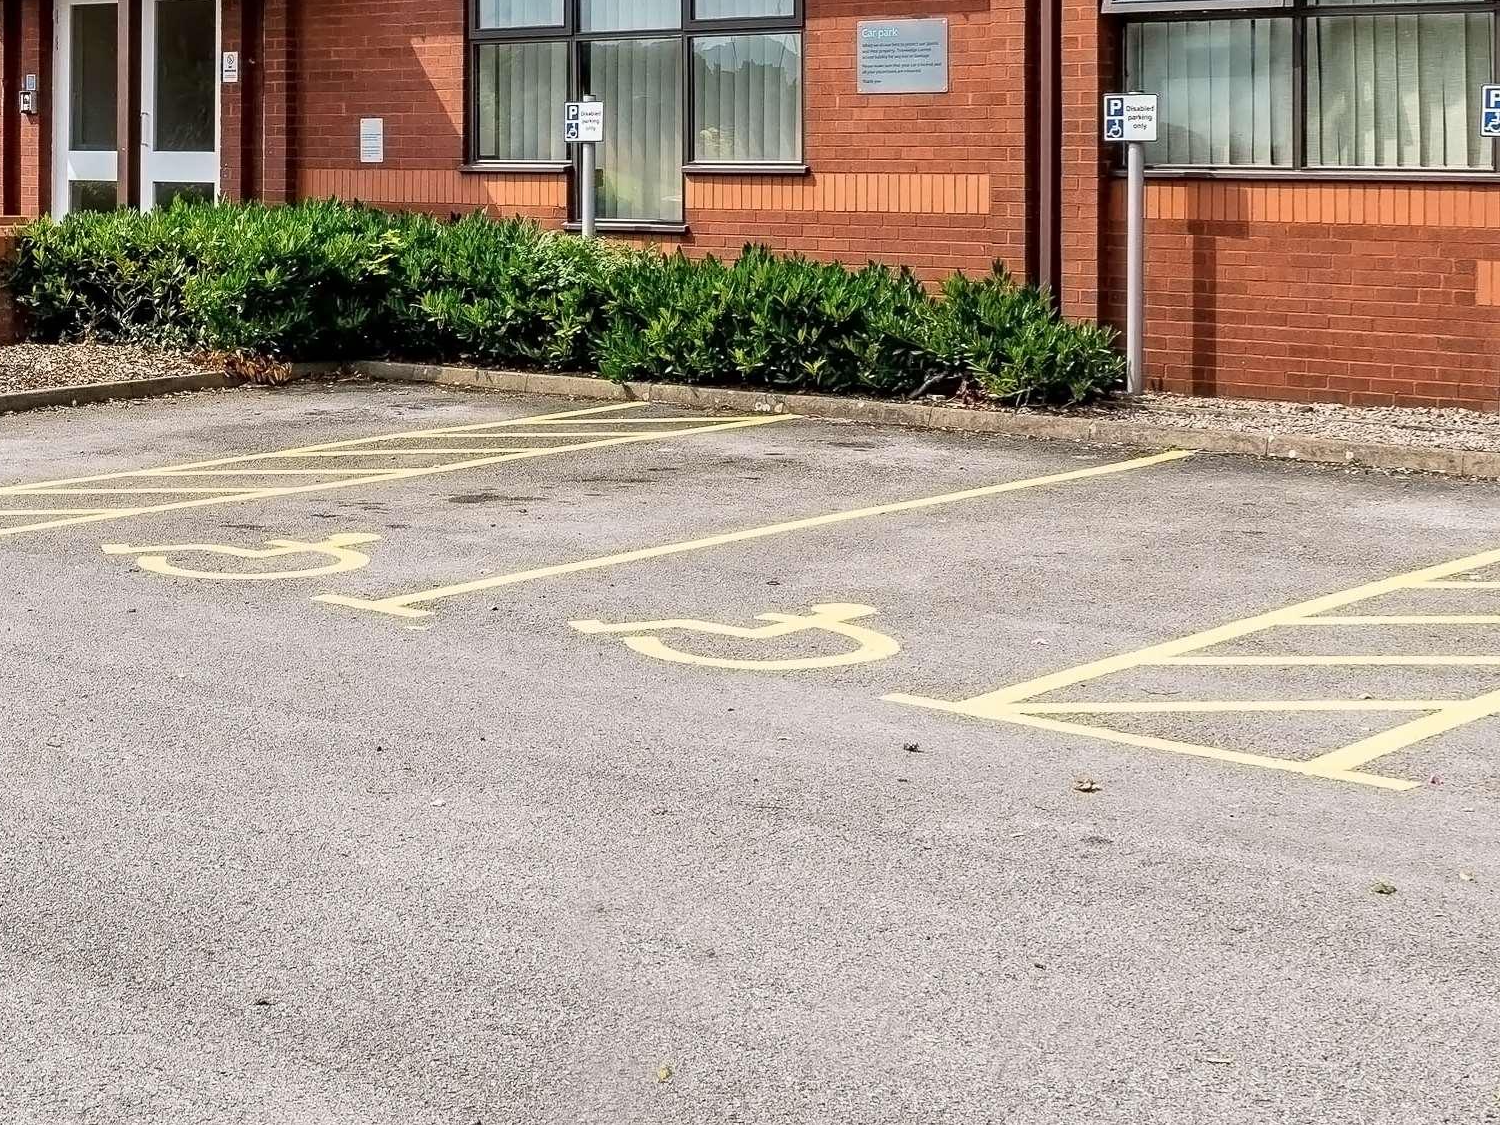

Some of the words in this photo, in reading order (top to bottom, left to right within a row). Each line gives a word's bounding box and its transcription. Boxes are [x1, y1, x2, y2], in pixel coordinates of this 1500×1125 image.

[861, 27, 877, 38] Car
[878, 27, 899, 39] park
[569, 106, 578, 120] P
[1110, 100, 1122, 115] P
[1127, 114, 1153, 122] parking
